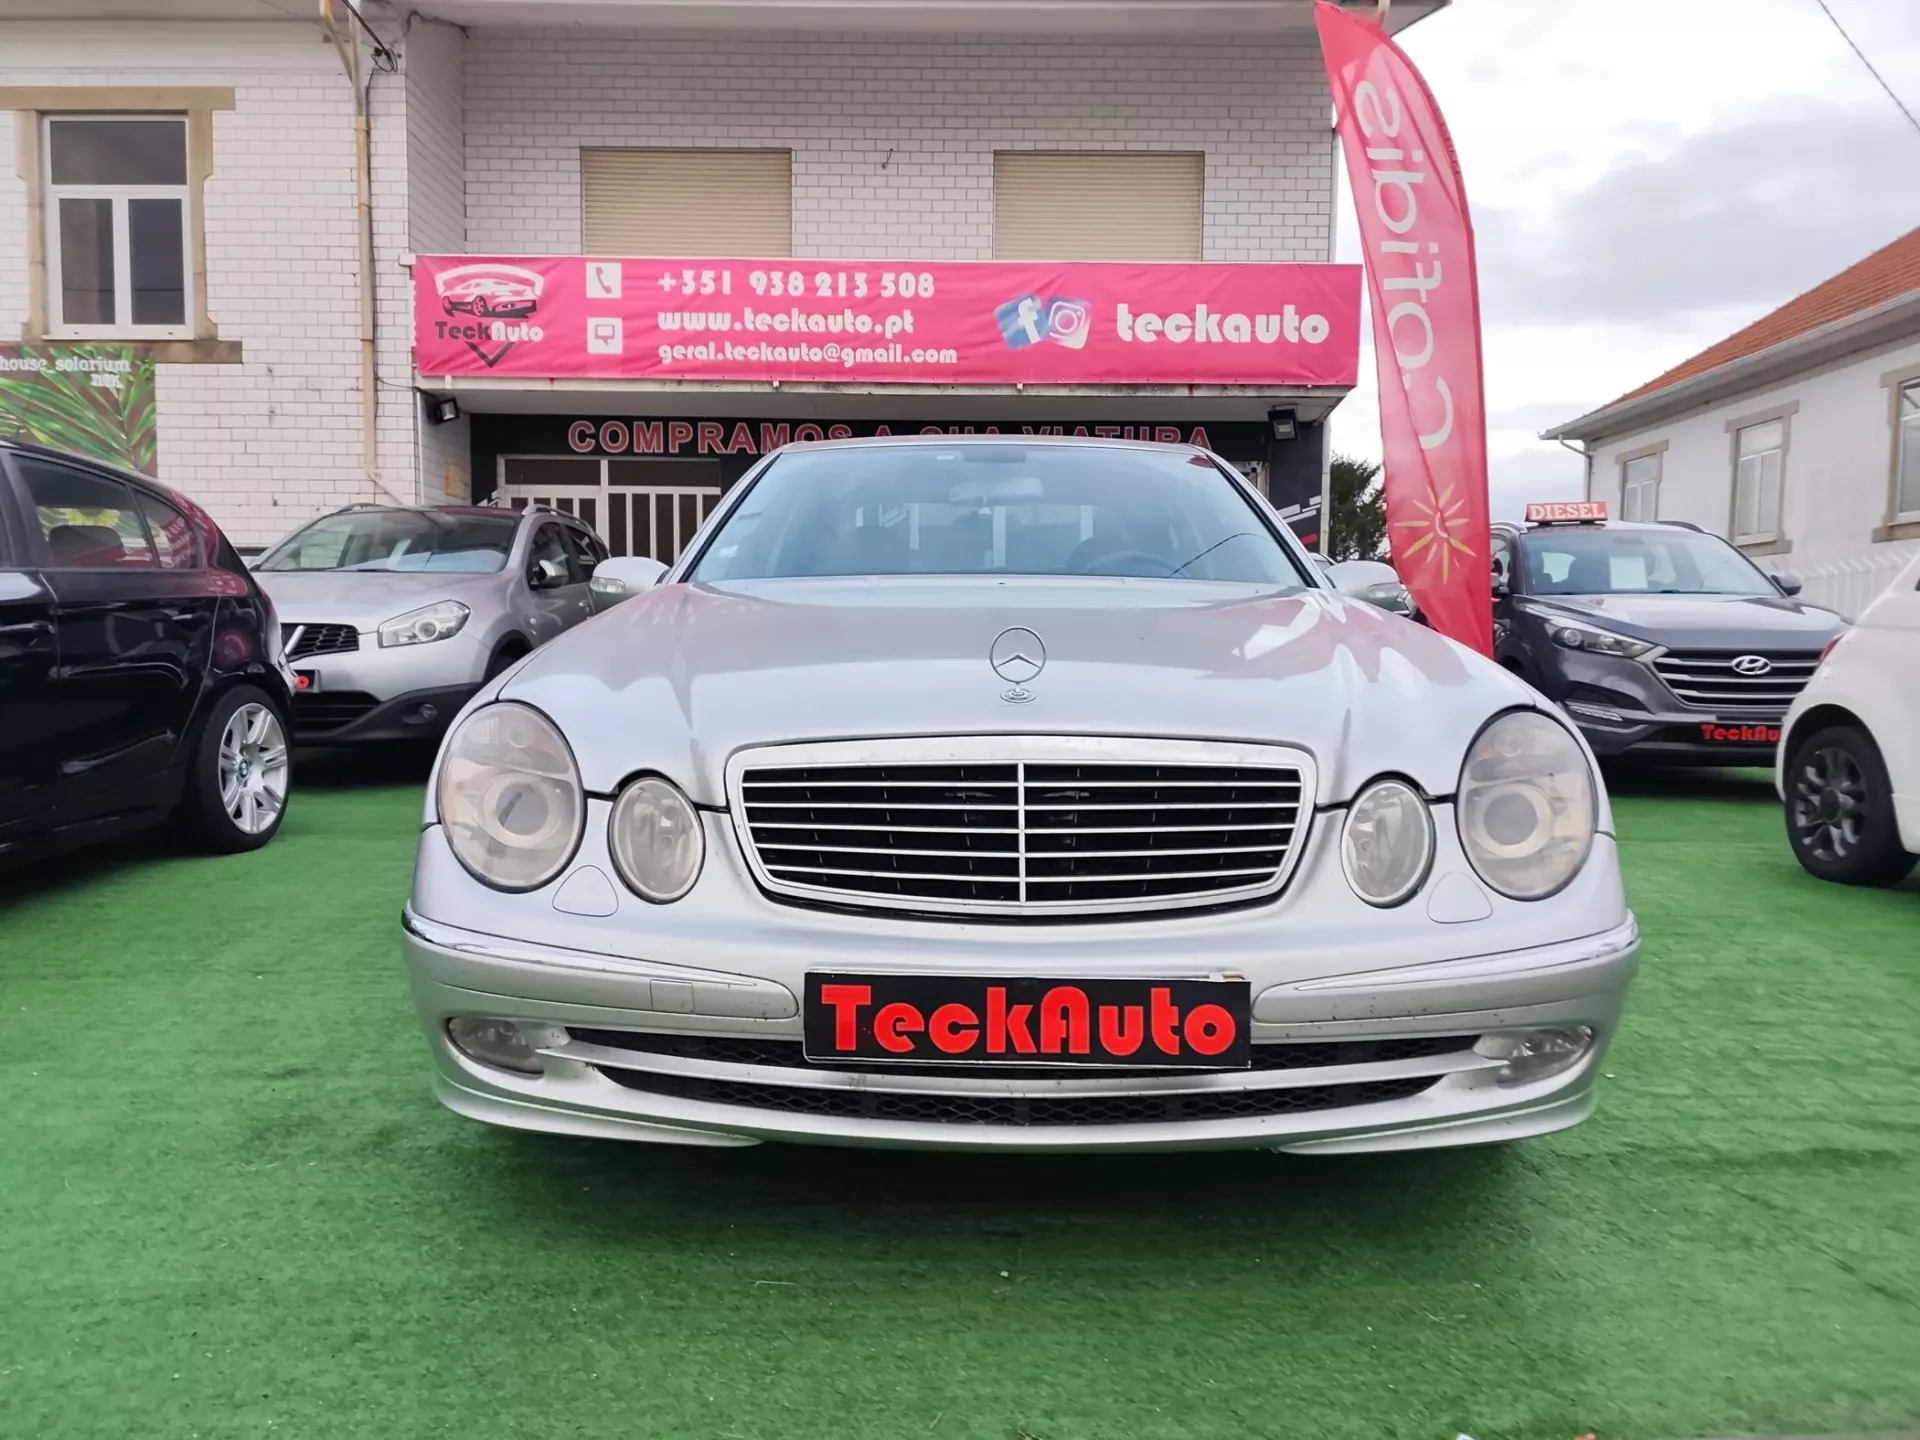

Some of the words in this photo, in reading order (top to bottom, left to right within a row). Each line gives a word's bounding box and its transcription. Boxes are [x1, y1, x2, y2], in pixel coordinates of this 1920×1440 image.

[658, 270, 731, 295] +351
[749, 271, 805, 296] 938
[815, 272, 868, 297] 213
[880, 272, 935, 298] 508
[434, 320, 545, 342] TeckAuto
[658, 307, 914, 339] www.teckauto.pt
[1116, 303, 1330, 344] teckauto
[658, 341, 958, 368] geral.teckauto@gmail.com
[1528, 502, 1605, 521] DIESEL
[1700, 723, 1780, 742] TeckAu
[821, 984, 1237, 1056] TeckAuto
